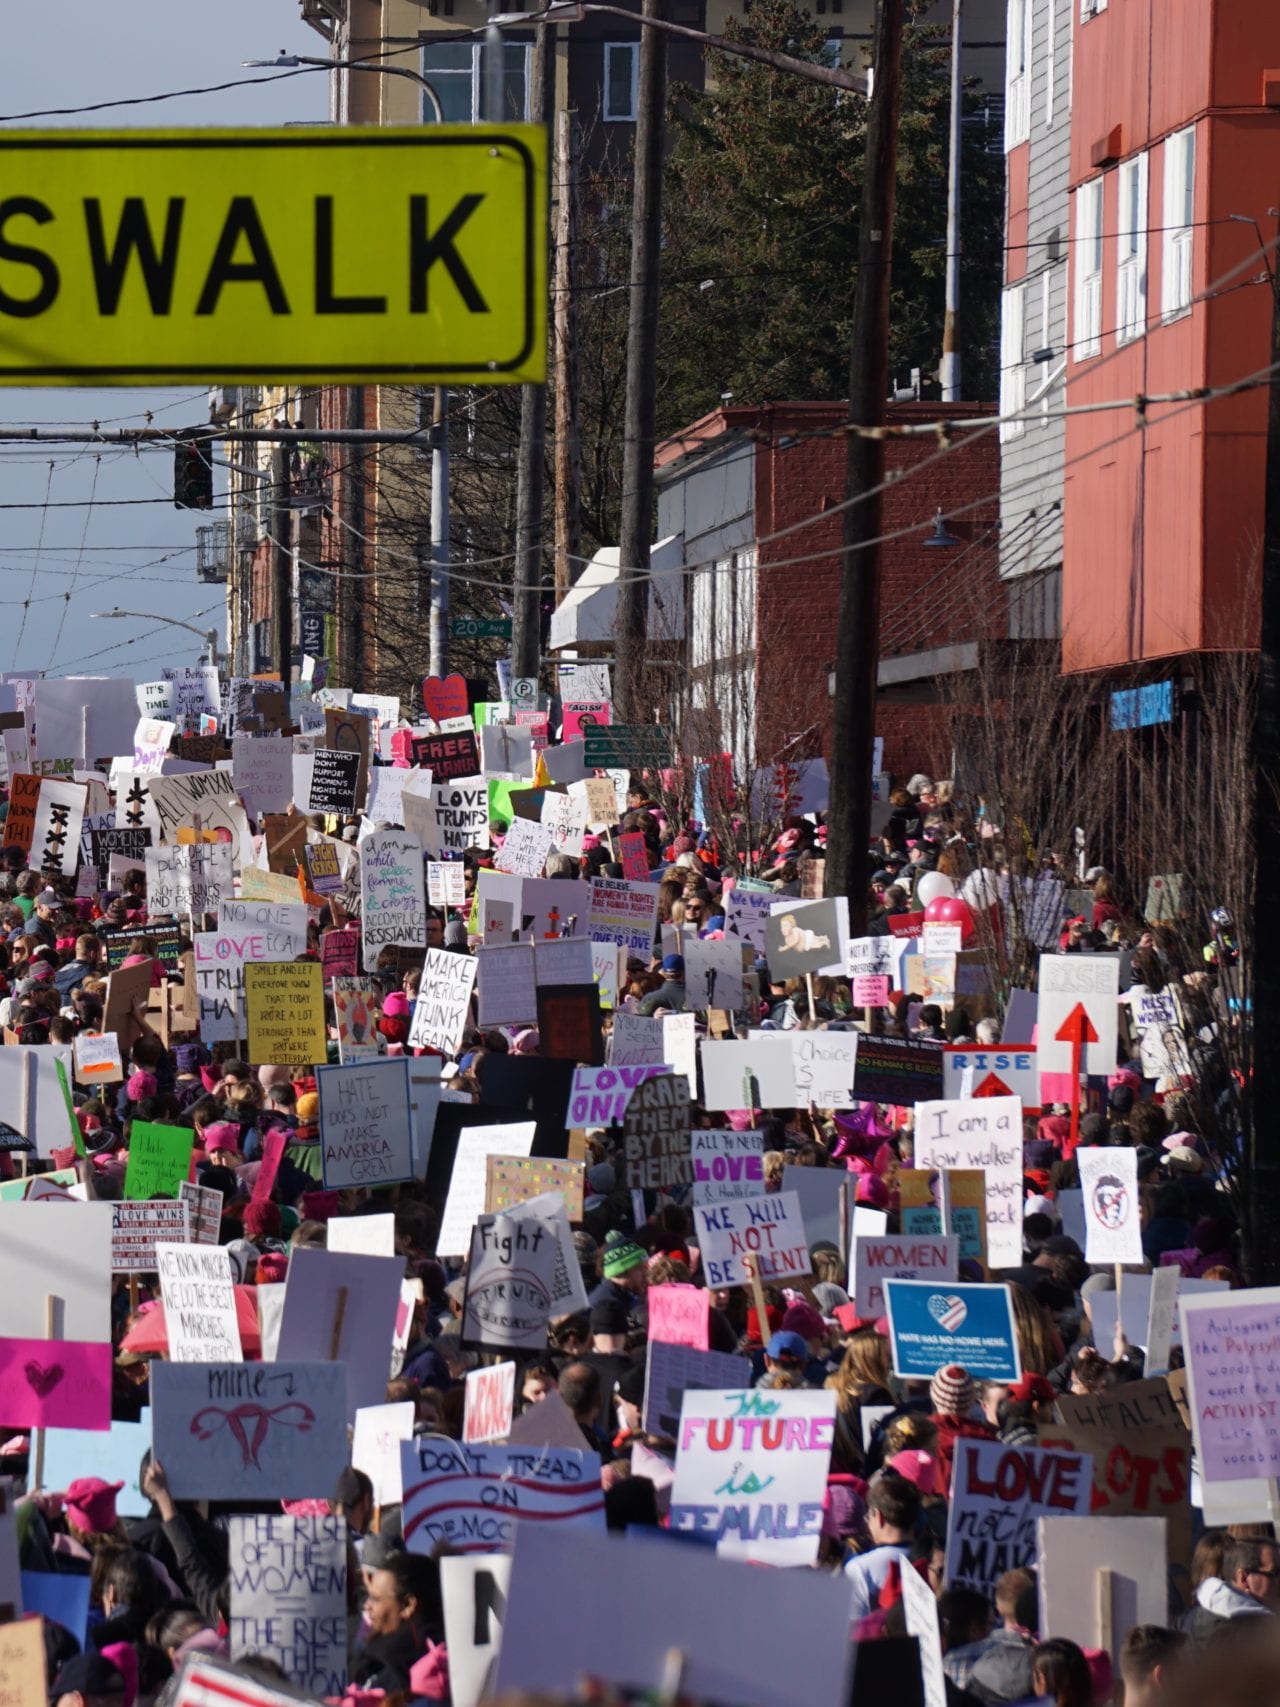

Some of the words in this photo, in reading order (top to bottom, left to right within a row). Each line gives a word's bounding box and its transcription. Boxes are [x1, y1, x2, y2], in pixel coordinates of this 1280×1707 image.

[456, 622, 484, 634] 20th
[489, 624, 504, 633] Ave
[146, 685, 164, 694] IT'S
[146, 702, 169, 710] TIME
[417, 740, 470, 758] FREE
[313, 778, 348, 786] WOMEN'S
[314, 769, 344, 777] SUPPORT
[438, 791, 486, 806] LOVE
[435, 811, 487, 826] TRUMPS
[97, 831, 145, 846] WOMEN'S
[444, 831, 480, 847] HATE
[150, 896, 170, 908] AND
[592, 889, 628, 901] WOMEN'S
[630, 893, 655, 905] RIGHTS
[223, 904, 246, 921] NO
[256, 908, 291, 925] ONE
[365, 912, 424, 926] ACCOMPLICE
[196, 936, 266, 961] LOVE
[365, 928, 425, 947] RESISTANCE
[253, 965, 278, 975] SMILE
[280, 965, 298, 975] AND
[298, 966, 312, 975] LET
[423, 949, 476, 983] MAKE
[1043, 960, 1115, 994] RISE
[419, 977, 468, 1002] AMERICA
[419, 1001, 464, 1026] THINK
[297, 1027, 316, 1036] THAN
[411, 1029, 458, 1057] AGAIN
[952, 1054, 1031, 1071] RISE
[337, 1076, 377, 1102] HATE
[328, 1109, 361, 1127] DOES
[365, 1105, 390, 1121] NOT
[627, 1110, 690, 1132] THEM
[931, 1110, 949, 1140] I
[958, 1113, 988, 1132] am
[996, 1115, 1009, 1130] a
[343, 1125, 378, 1142] MAKE
[626, 1134, 659, 1160] BY
[659, 1131, 691, 1154] THE
[326, 1142, 392, 1163] AMERICA
[922, 1149, 961, 1169] slow
[968, 1142, 1020, 1166] walker
[350, 1157, 395, 1181] GREAT
[627, 1154, 695, 1188] HEART
[695, 1155, 763, 1181] LOVE
[121, 1209, 148, 1220] LOVE
[156, 1210, 184, 1219] WINS
[480, 1220, 543, 1263] Fight
[731, 1225, 776, 1251] NOT
[865, 1245, 948, 1268] WOMEN
[181, 1312, 225, 1339] MARCHES
[208, 1365, 266, 1399] mine
[725, 1392, 782, 1417] The
[1203, 1401, 1277, 1420] ACTIVIST
[681, 1416, 837, 1453] FUTURE
[420, 1448, 487, 1477] DON'T
[507, 1453, 583, 1482] TREAD
[713, 1461, 775, 1496] is
[966, 1447, 1082, 1511] LOVE
[479, 1486, 518, 1507] ON
[229, 1514, 282, 1541] THE
[294, 1515, 346, 1544] RISE
[672, 1502, 822, 1541] FEMALE
[241, 1543, 268, 1564] OF
[275, 1543, 322, 1567] THE
[231, 1566, 346, 1593] WOMEN
[231, 1617, 282, 1644] THE
[294, 1617, 346, 1648] RISE
